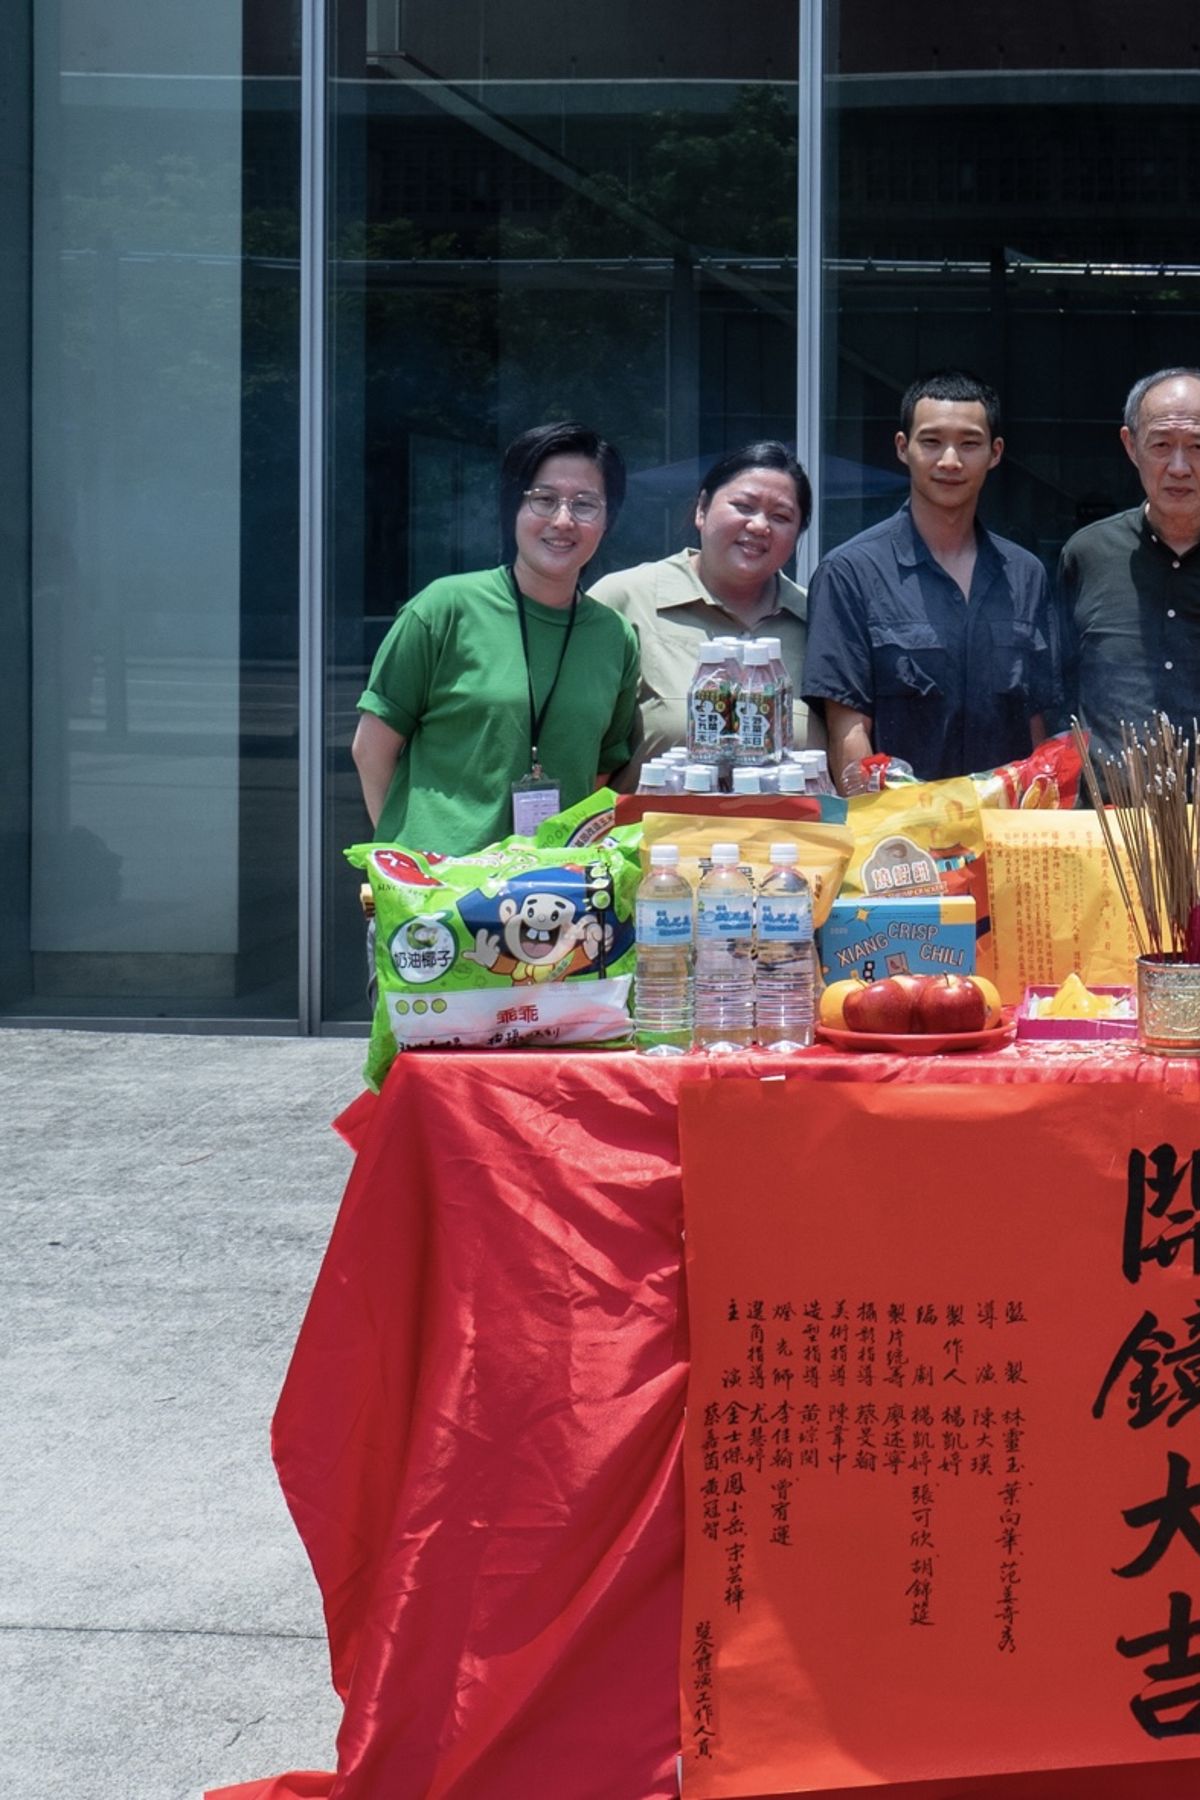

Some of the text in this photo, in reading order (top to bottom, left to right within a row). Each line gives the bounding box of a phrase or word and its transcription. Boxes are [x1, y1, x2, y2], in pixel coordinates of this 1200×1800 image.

[394, 950, 451, 968] 奶油椰子
[834, 921, 964, 968] XIANG CRISP CHILI
[497, 1005, 539, 1024] 乖乖
[721, 1299, 742, 1388] 主演
[803, 1299, 823, 1388] 造型指導
[829, 1299, 850, 1387] 美術指導
[912, 1303, 938, 1387] 編劇
[943, 1304, 966, 1385] 製作人
[977, 1299, 998, 1384] 導演
[1005, 1301, 1027, 1384] 監製
